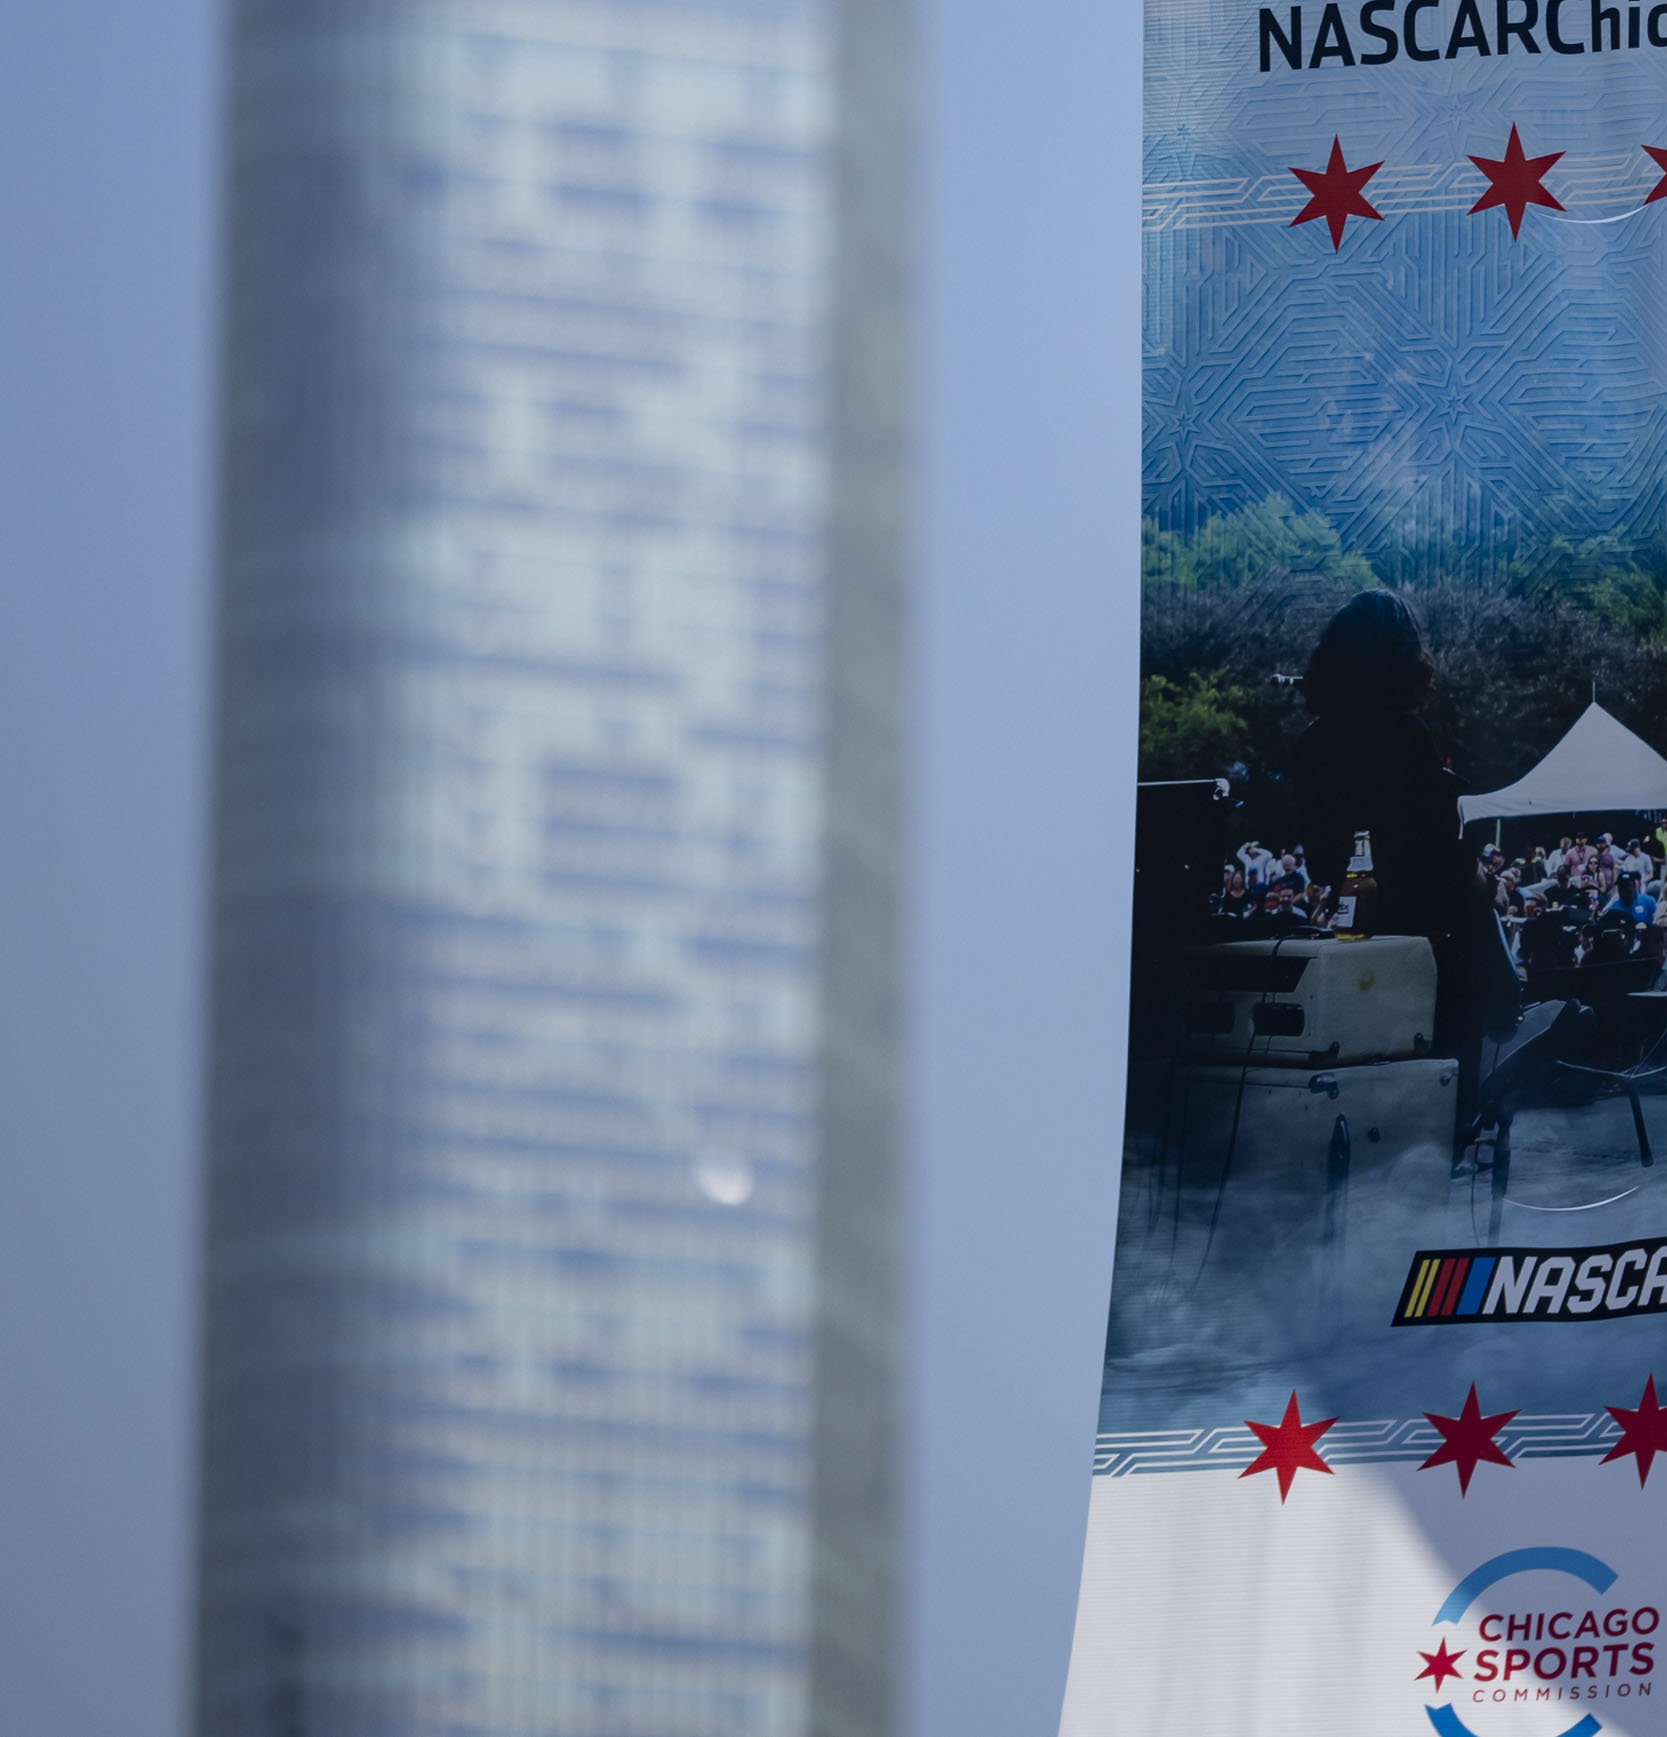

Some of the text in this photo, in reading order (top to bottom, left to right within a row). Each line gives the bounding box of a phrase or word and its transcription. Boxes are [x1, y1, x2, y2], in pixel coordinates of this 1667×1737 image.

[1479, 1606, 1660, 1642] CHICAGO
[1473, 1642, 1655, 1682] SPORTS
[1472, 1682, 1652, 1704] COMMISSION
